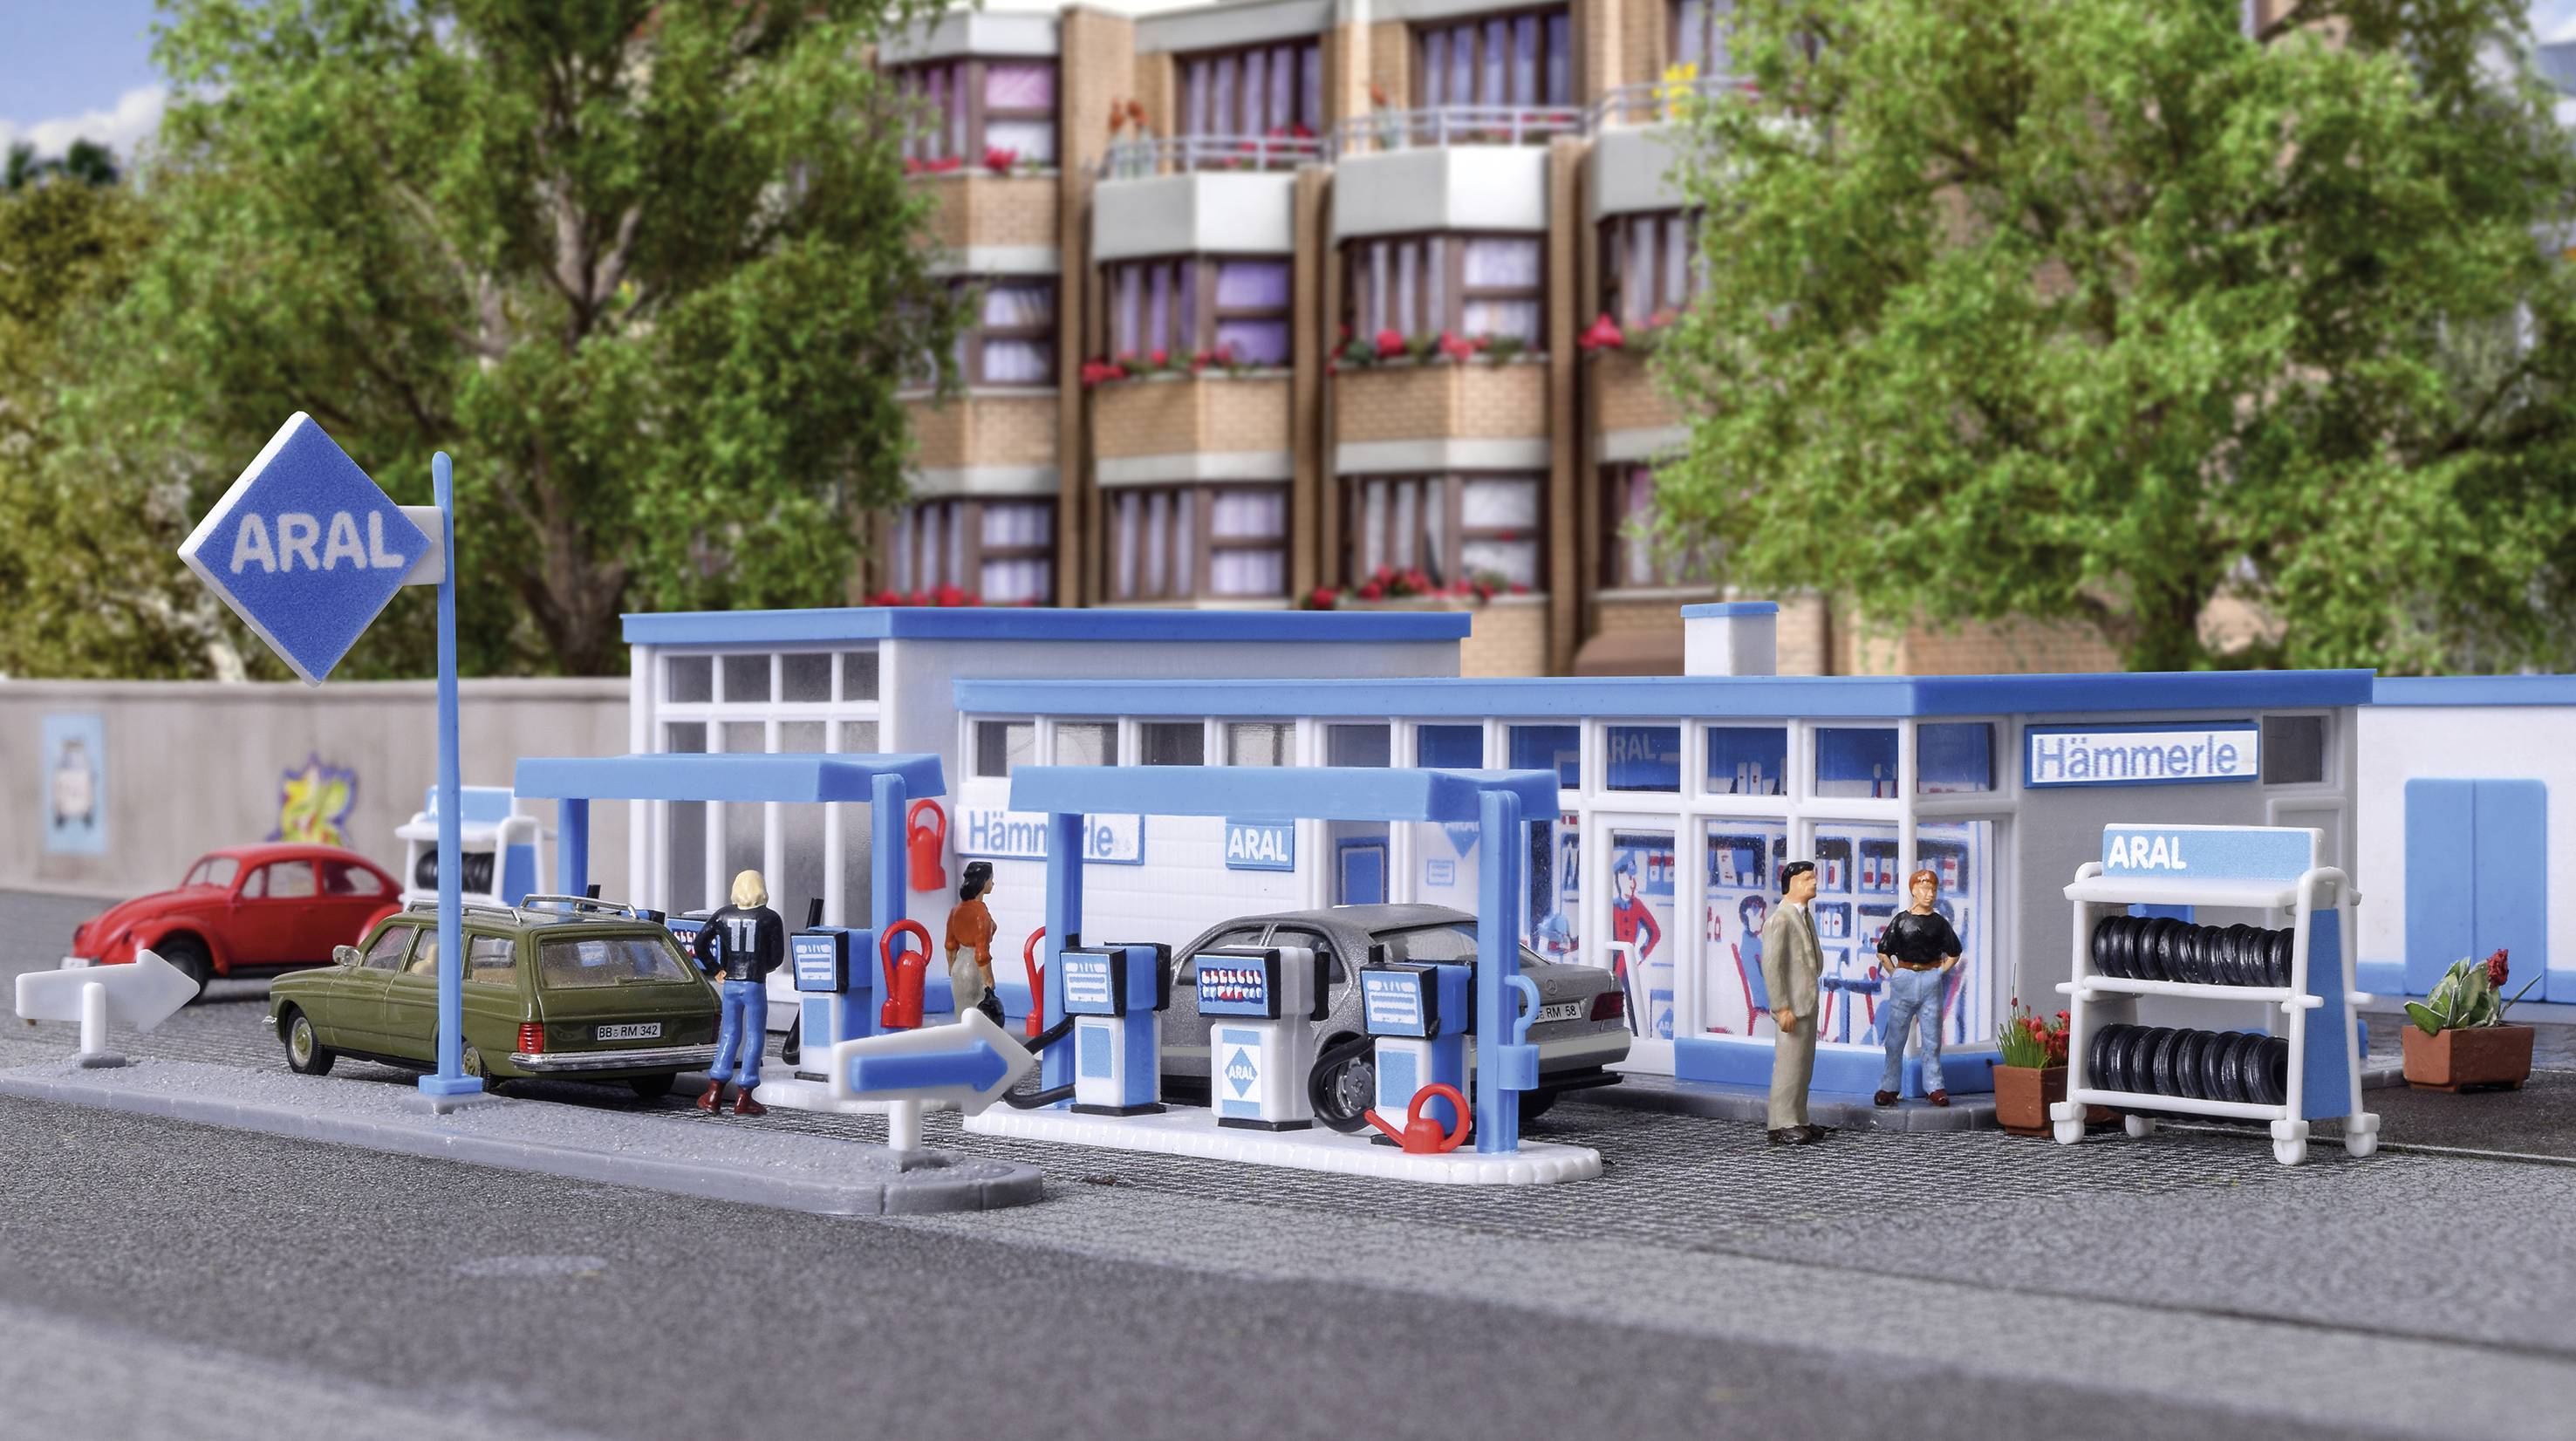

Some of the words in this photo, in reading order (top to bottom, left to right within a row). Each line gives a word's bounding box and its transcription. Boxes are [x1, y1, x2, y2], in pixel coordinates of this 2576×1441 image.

[230, 510, 405, 574] ARAL
[1607, 733, 1657, 764] RAL
[2037, 734, 2238, 778] Hämmerle
[1228, 828, 1288, 861] ARAL
[2108, 836, 2187, 870] ARAL
[728, 919, 756, 953] 11
[1547, 1007, 1561, 1019] RM
[1565, 1005, 1576, 1017] 58
[598, 1027, 612, 1038] BB
[620, 1026, 638, 1037] RM
[639, 1025, 658, 1035] 342
[1229, 1064, 1254, 1080] ARAL
